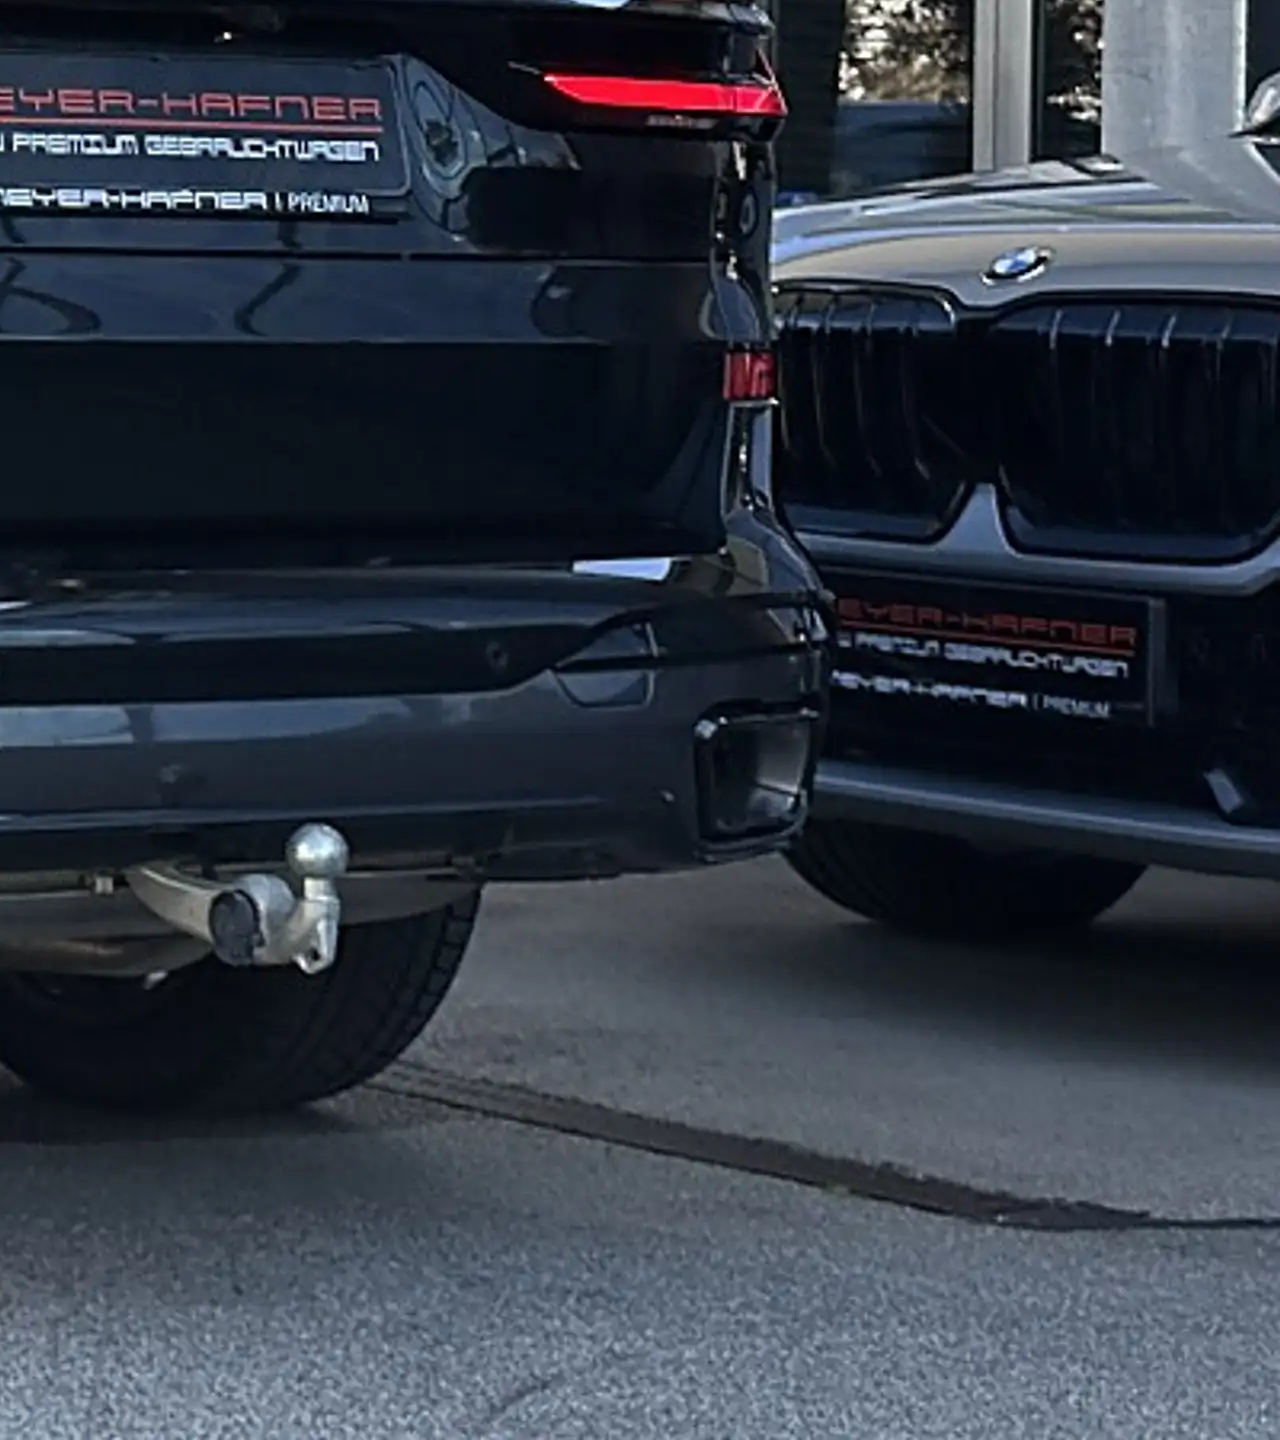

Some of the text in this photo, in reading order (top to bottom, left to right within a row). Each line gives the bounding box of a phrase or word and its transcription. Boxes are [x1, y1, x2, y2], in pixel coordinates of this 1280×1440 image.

[13, 133, 139, 155] PREMIUM
[144, 134, 379, 161] GEBRAUCHTWAGEN
[288, 191, 370, 214] PREMIUM
[838, 597, 1137, 645] EYER-HAFNER
